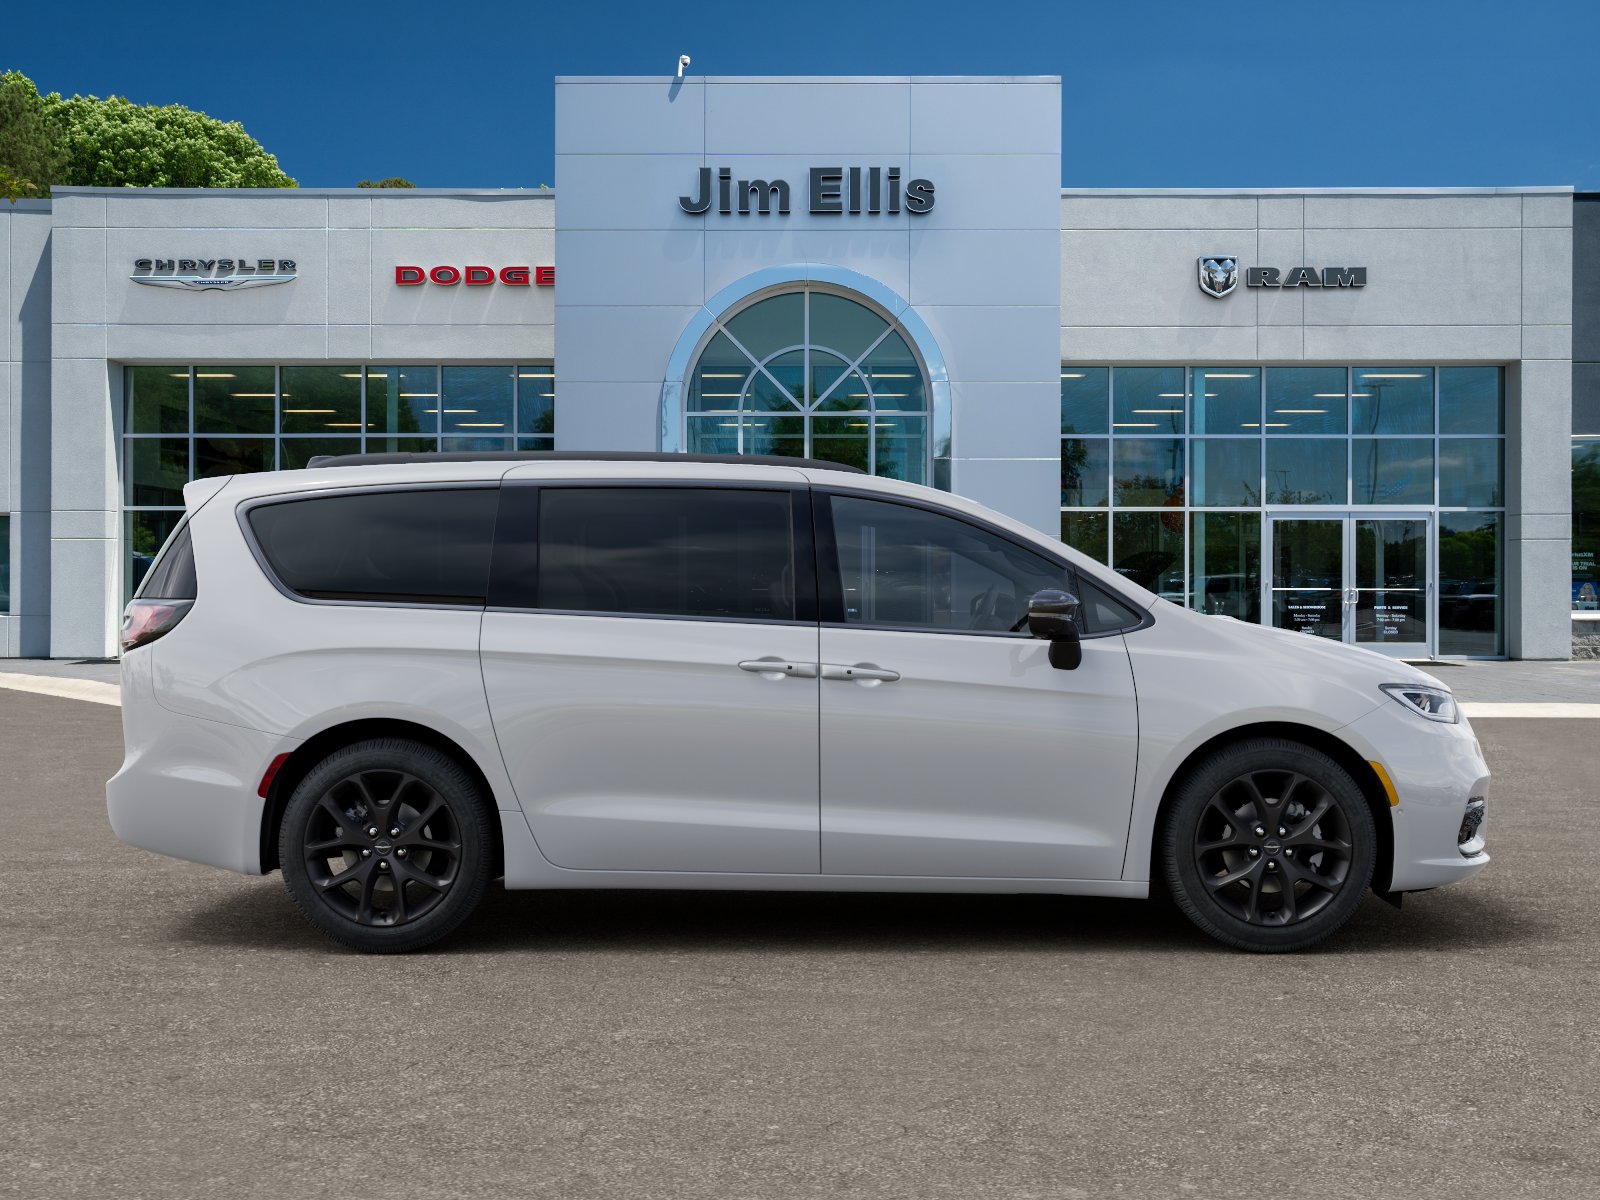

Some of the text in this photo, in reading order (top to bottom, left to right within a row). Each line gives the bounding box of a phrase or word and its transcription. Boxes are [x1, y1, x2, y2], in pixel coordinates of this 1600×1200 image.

[679, 167, 935, 213] Jim Ellis
[134, 259, 297, 270] CHRYSLER
[395, 266, 555, 286] DODGE
[1247, 267, 1367, 287] RAM
